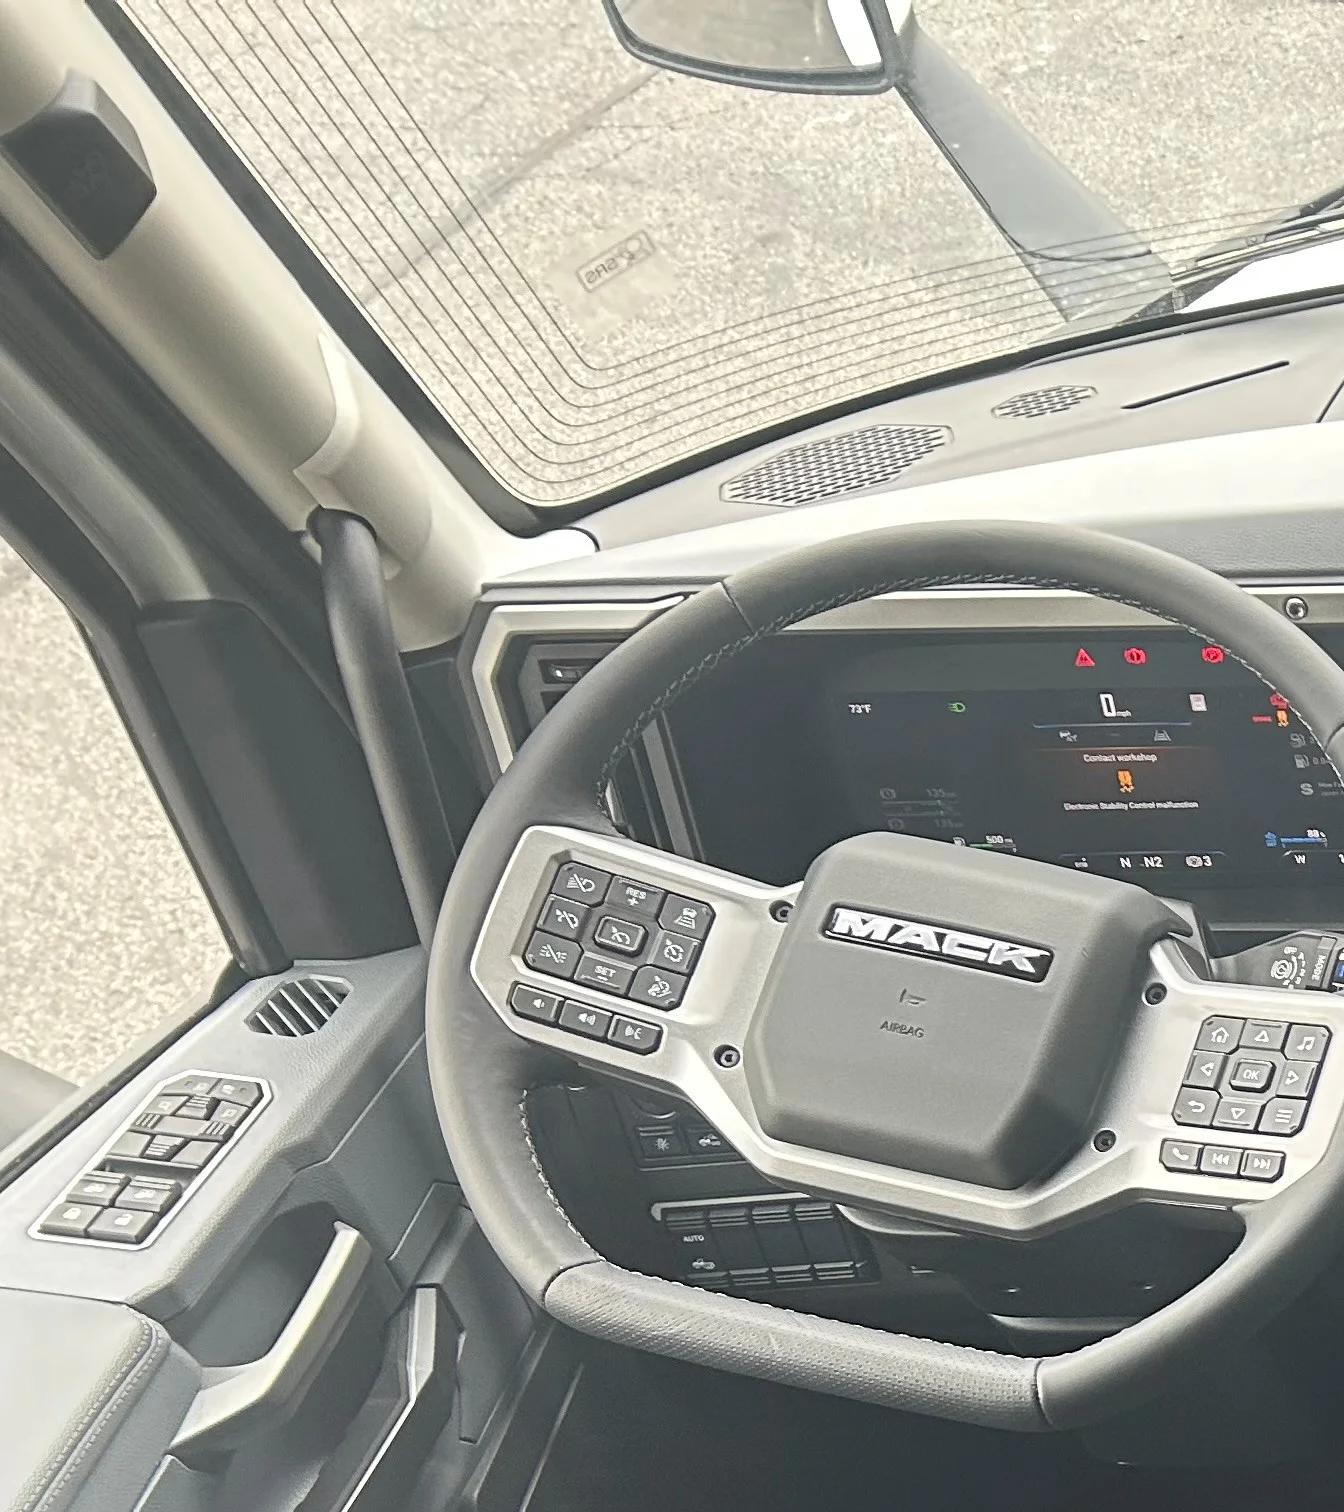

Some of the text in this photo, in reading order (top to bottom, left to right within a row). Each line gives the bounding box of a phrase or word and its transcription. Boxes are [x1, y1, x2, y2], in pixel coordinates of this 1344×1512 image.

[848, 704, 871, 714] 73°F
[1100, 693, 1117, 718] 0
[1083, 752, 1158, 763] Contact workshop
[1063, 801, 1199, 811] Electronic Stability Control malfunction
[1119, 855, 1212, 868] N N2 3
[1294, 854, 1306, 864] W
[625, 886, 647, 900] RES
[832, 907, 1051, 973] MACK
[594, 965, 617, 978] SET
[1312, 954, 1327, 981] MODE
[880, 1020, 926, 1039] AIRBAG
[1242, 1069, 1261, 1081] OK
[683, 1234, 705, 1242] AUTO
